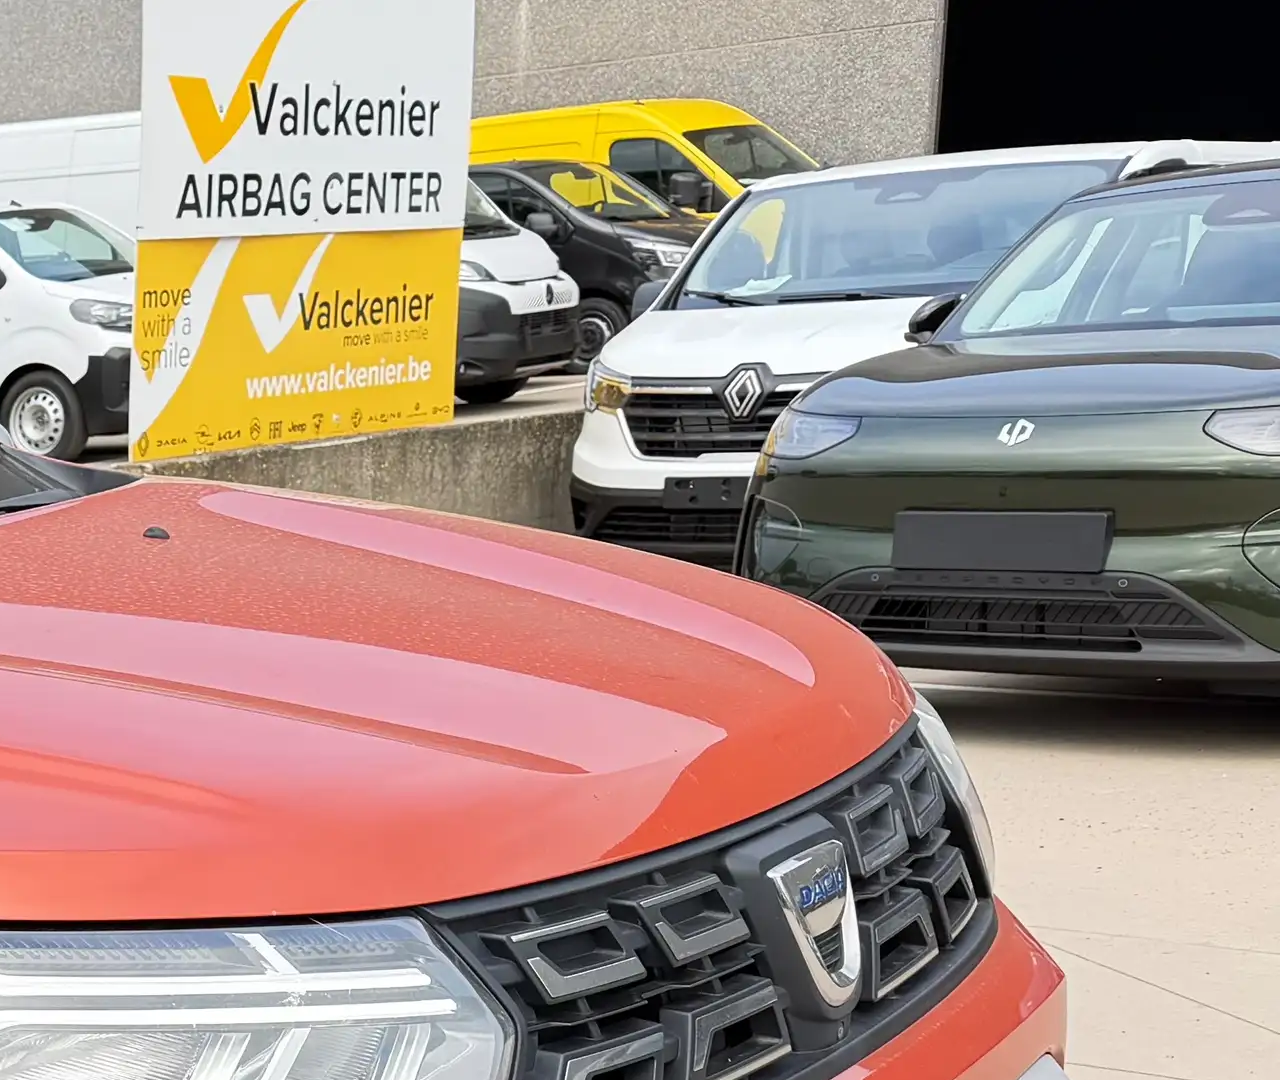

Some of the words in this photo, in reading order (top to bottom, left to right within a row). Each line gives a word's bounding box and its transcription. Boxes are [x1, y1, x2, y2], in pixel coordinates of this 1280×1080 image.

[249, 81, 440, 137] Valckenier
[175, 171, 312, 219] AIRBAG
[322, 170, 441, 215] CENTER
[142, 288, 192, 308] move
[299, 282, 434, 331] Valckenier
[142, 313, 176, 338] with
[181, 317, 192, 336] a
[343, 333, 371, 347] move
[374, 330, 393, 343] with
[404, 327, 428, 343] smile
[140, 341, 190, 371] smile
[246, 355, 432, 399] www.valckenier.be
